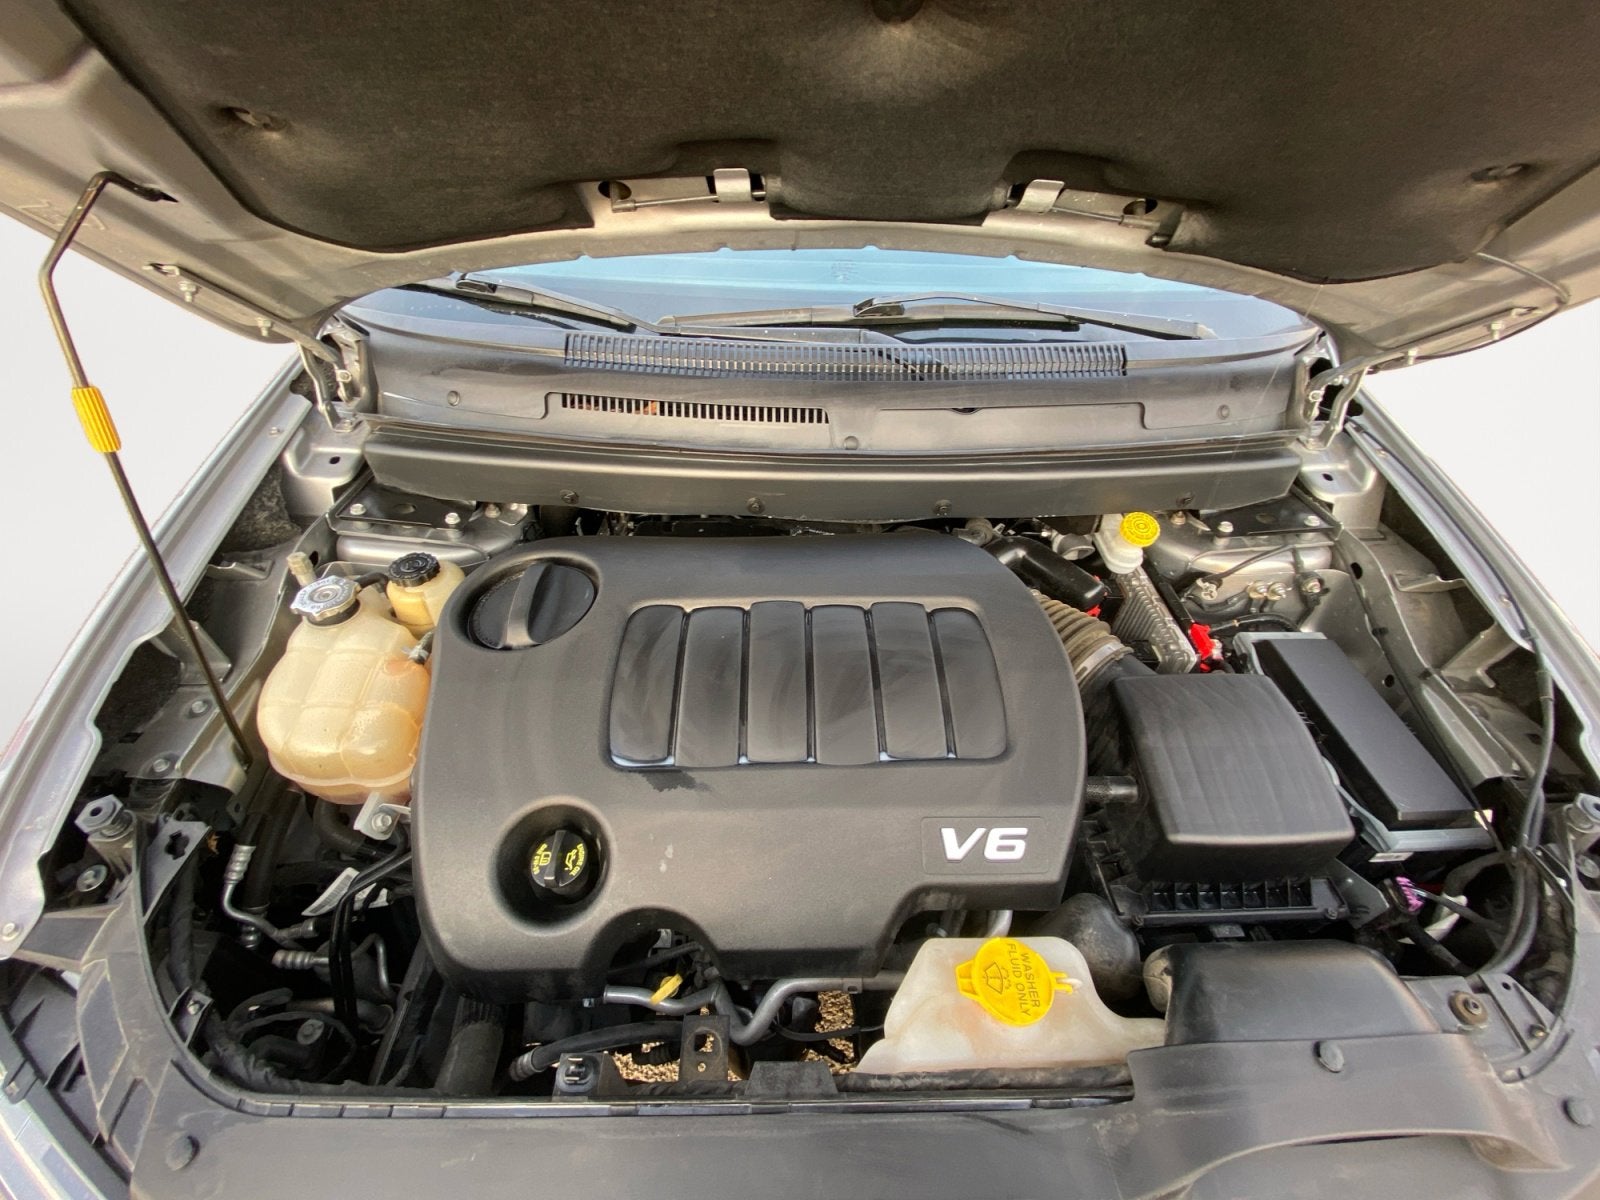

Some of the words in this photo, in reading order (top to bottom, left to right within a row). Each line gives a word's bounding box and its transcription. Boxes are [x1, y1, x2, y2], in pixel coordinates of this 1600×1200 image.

[940, 827, 1028, 861] V6
[1007, 943, 1022, 979] FLUID
[1015, 982, 1031, 1017] ONLY
[1020, 952, 1041, 1008] WASHER
